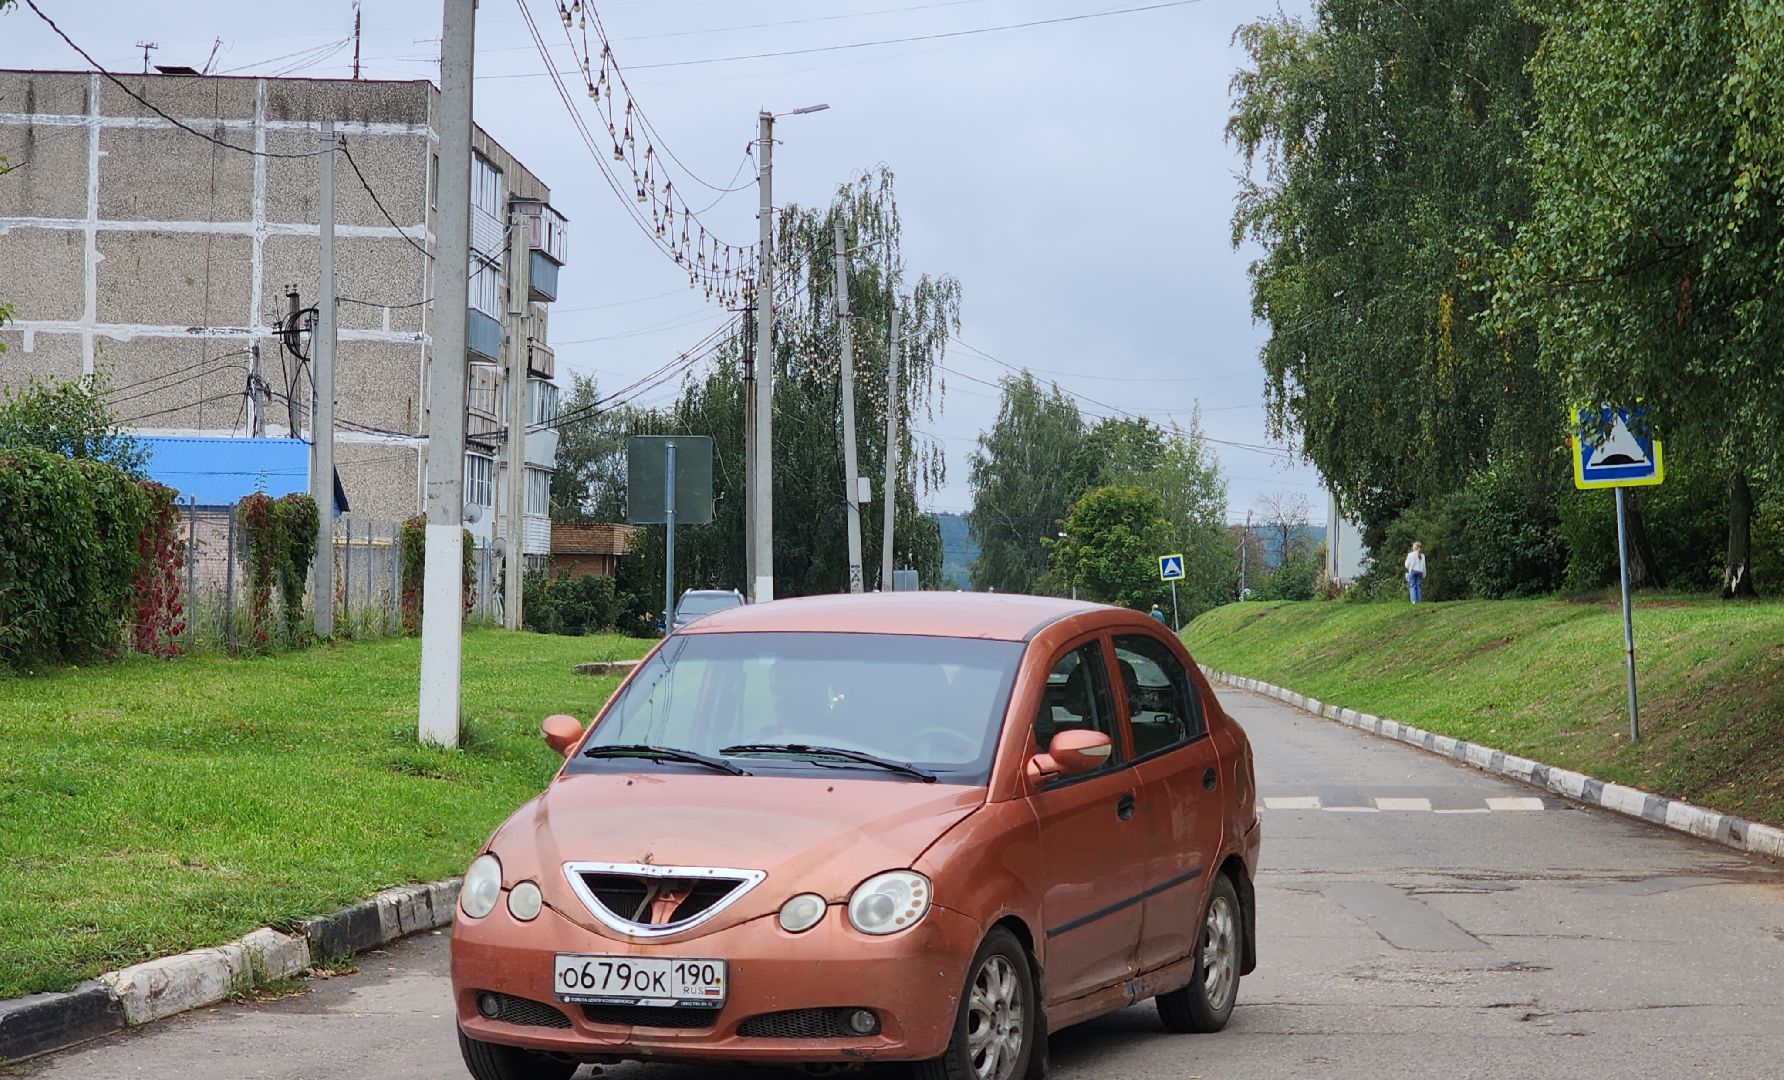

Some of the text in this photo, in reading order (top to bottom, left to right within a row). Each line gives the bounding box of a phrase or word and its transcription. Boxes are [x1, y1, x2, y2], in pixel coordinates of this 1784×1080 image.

[563, 962, 715, 992] О679ОК 190
[683, 986, 704, 995] RUS
